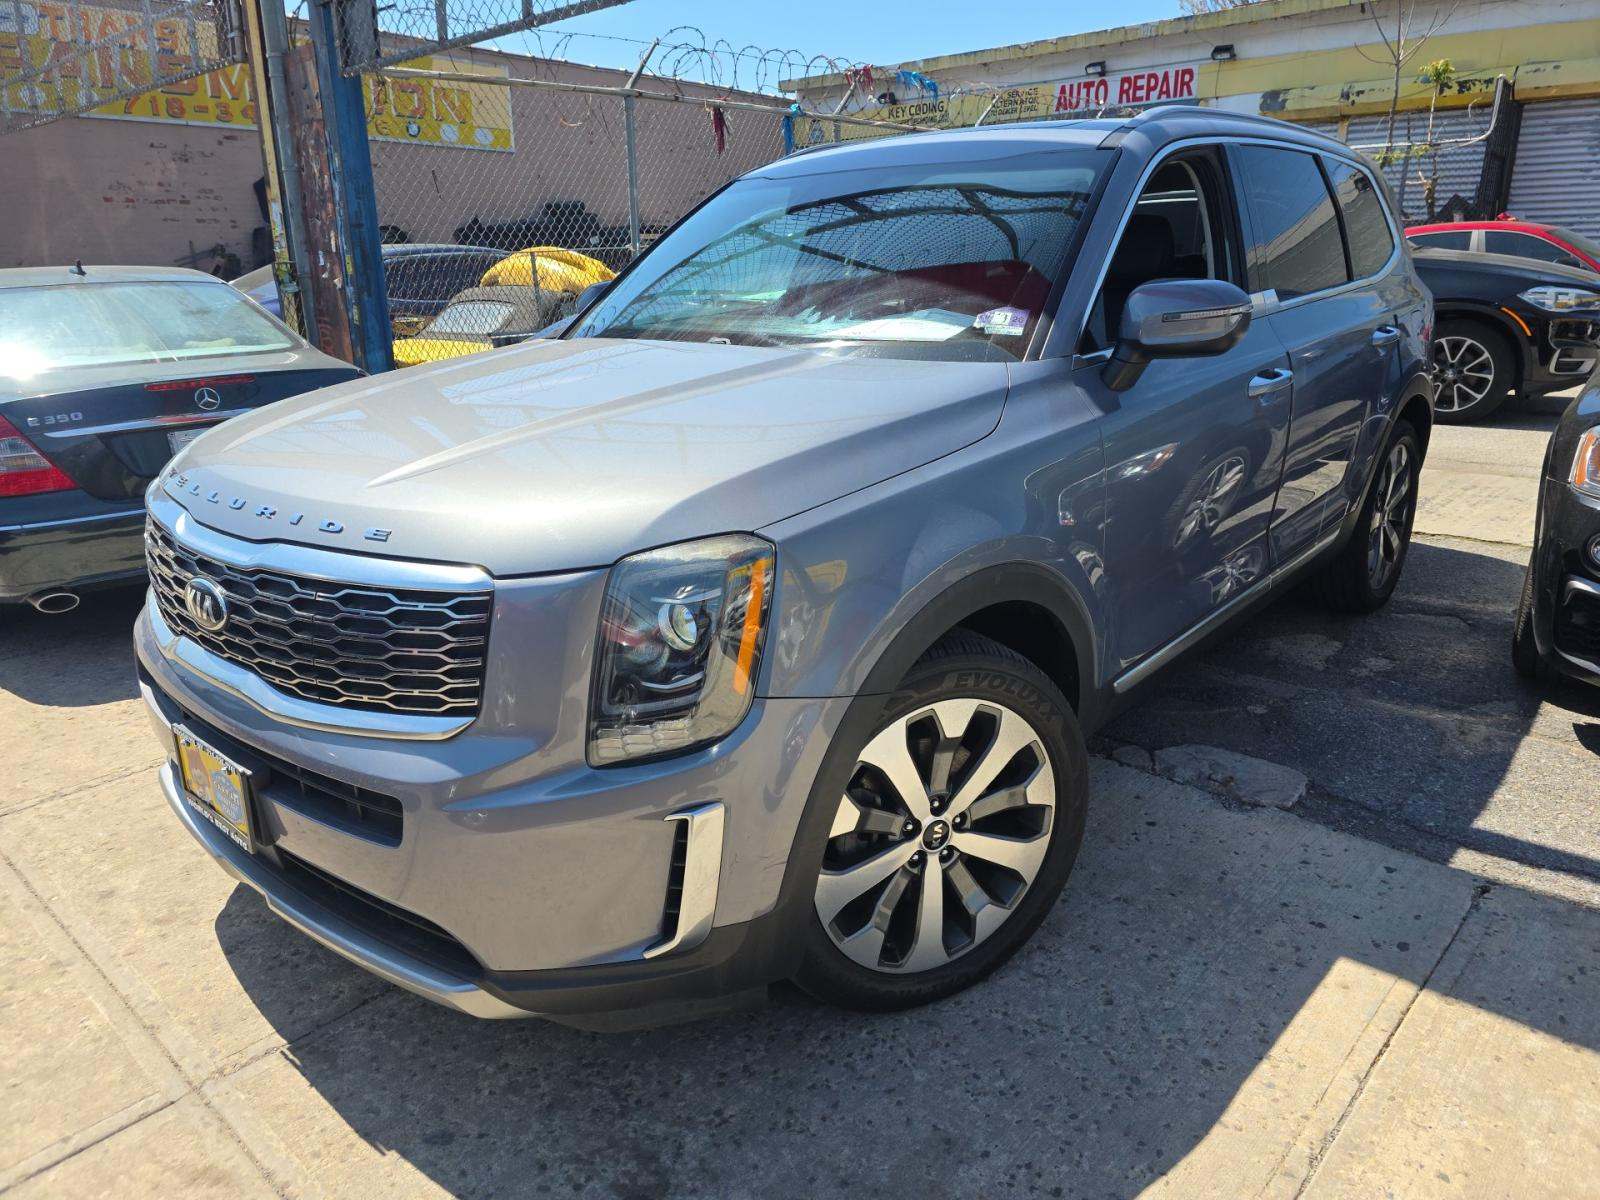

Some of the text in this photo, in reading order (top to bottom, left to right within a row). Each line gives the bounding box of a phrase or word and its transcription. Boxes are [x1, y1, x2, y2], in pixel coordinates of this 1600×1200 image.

[1007, 87, 1039, 98] SERVICE
[1054, 68, 1195, 112] AUTO REPAIR
[888, 104, 906, 119] KEY
[908, 100, 944, 116] CODING
